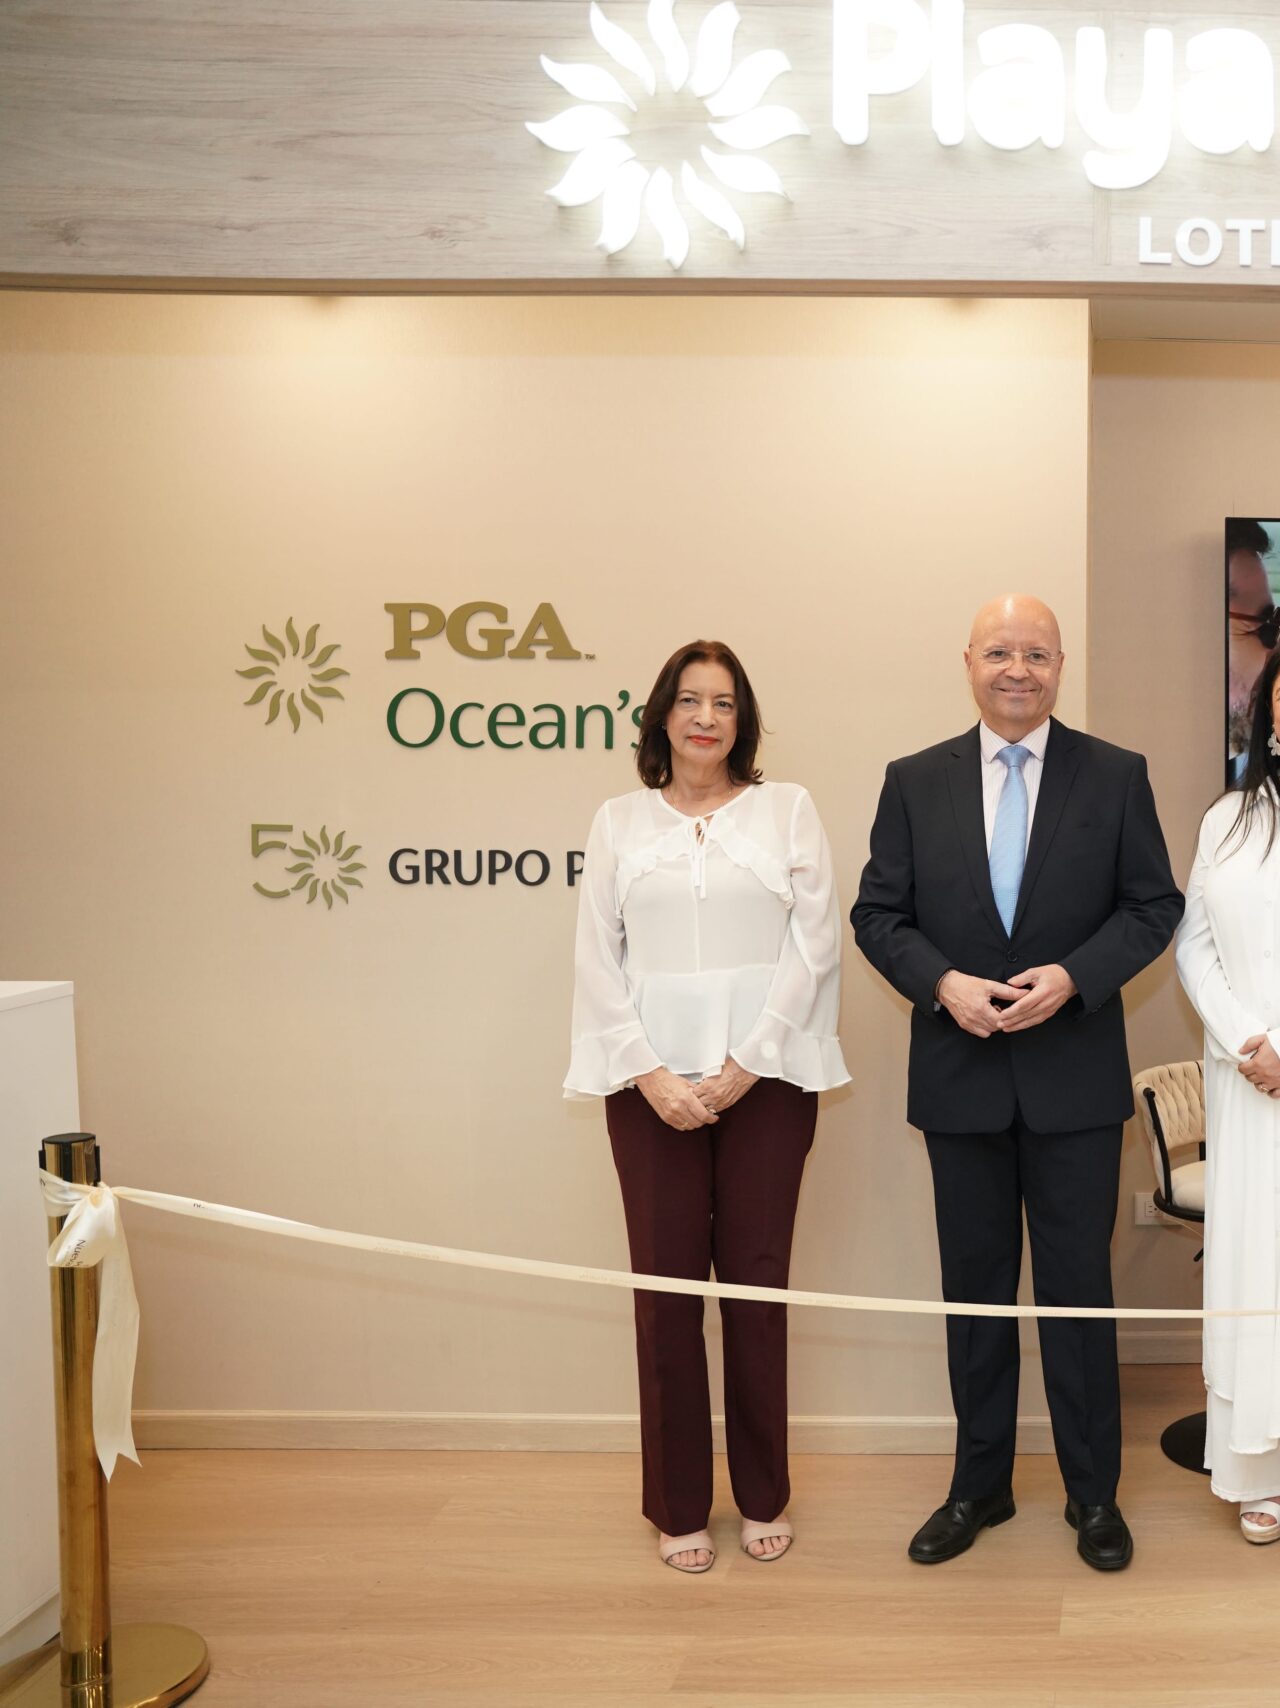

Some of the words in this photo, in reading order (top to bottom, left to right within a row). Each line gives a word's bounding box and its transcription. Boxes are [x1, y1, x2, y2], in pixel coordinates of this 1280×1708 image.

[832, 0, 1274, 189] Playa
[384, 601, 581, 660] PGA
[388, 848, 550, 887] GRUPO
